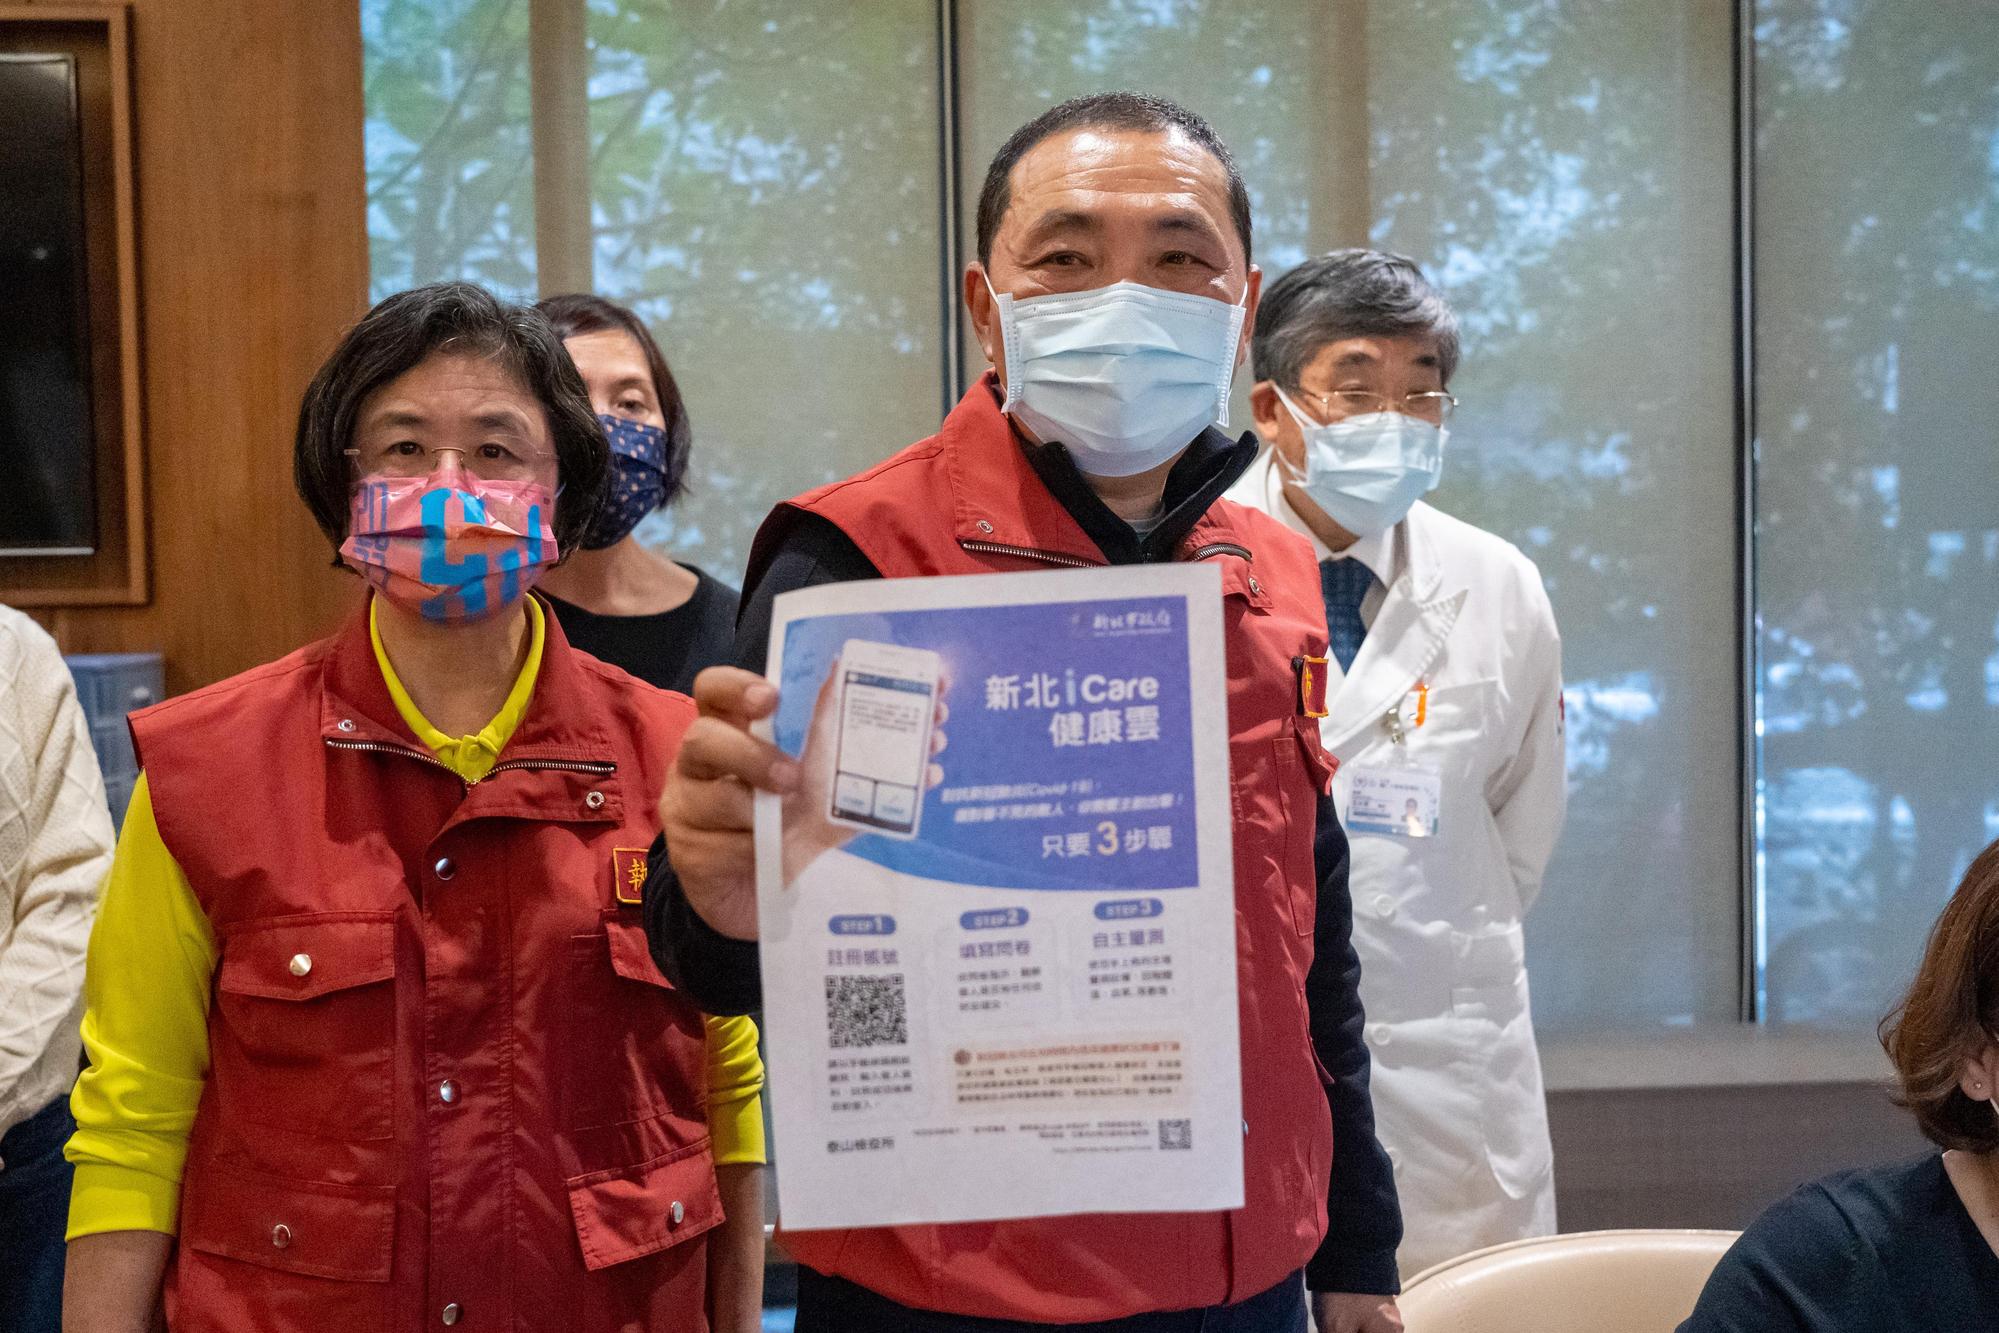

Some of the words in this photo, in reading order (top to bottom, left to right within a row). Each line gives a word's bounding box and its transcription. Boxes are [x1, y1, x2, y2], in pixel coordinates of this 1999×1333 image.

[1049, 704, 1160, 748] 健康雲
[1093, 928, 1165, 949] 自主量測
[827, 949, 899, 966] 註冊帳號
[959, 939, 1031, 959] 填寫問卷
